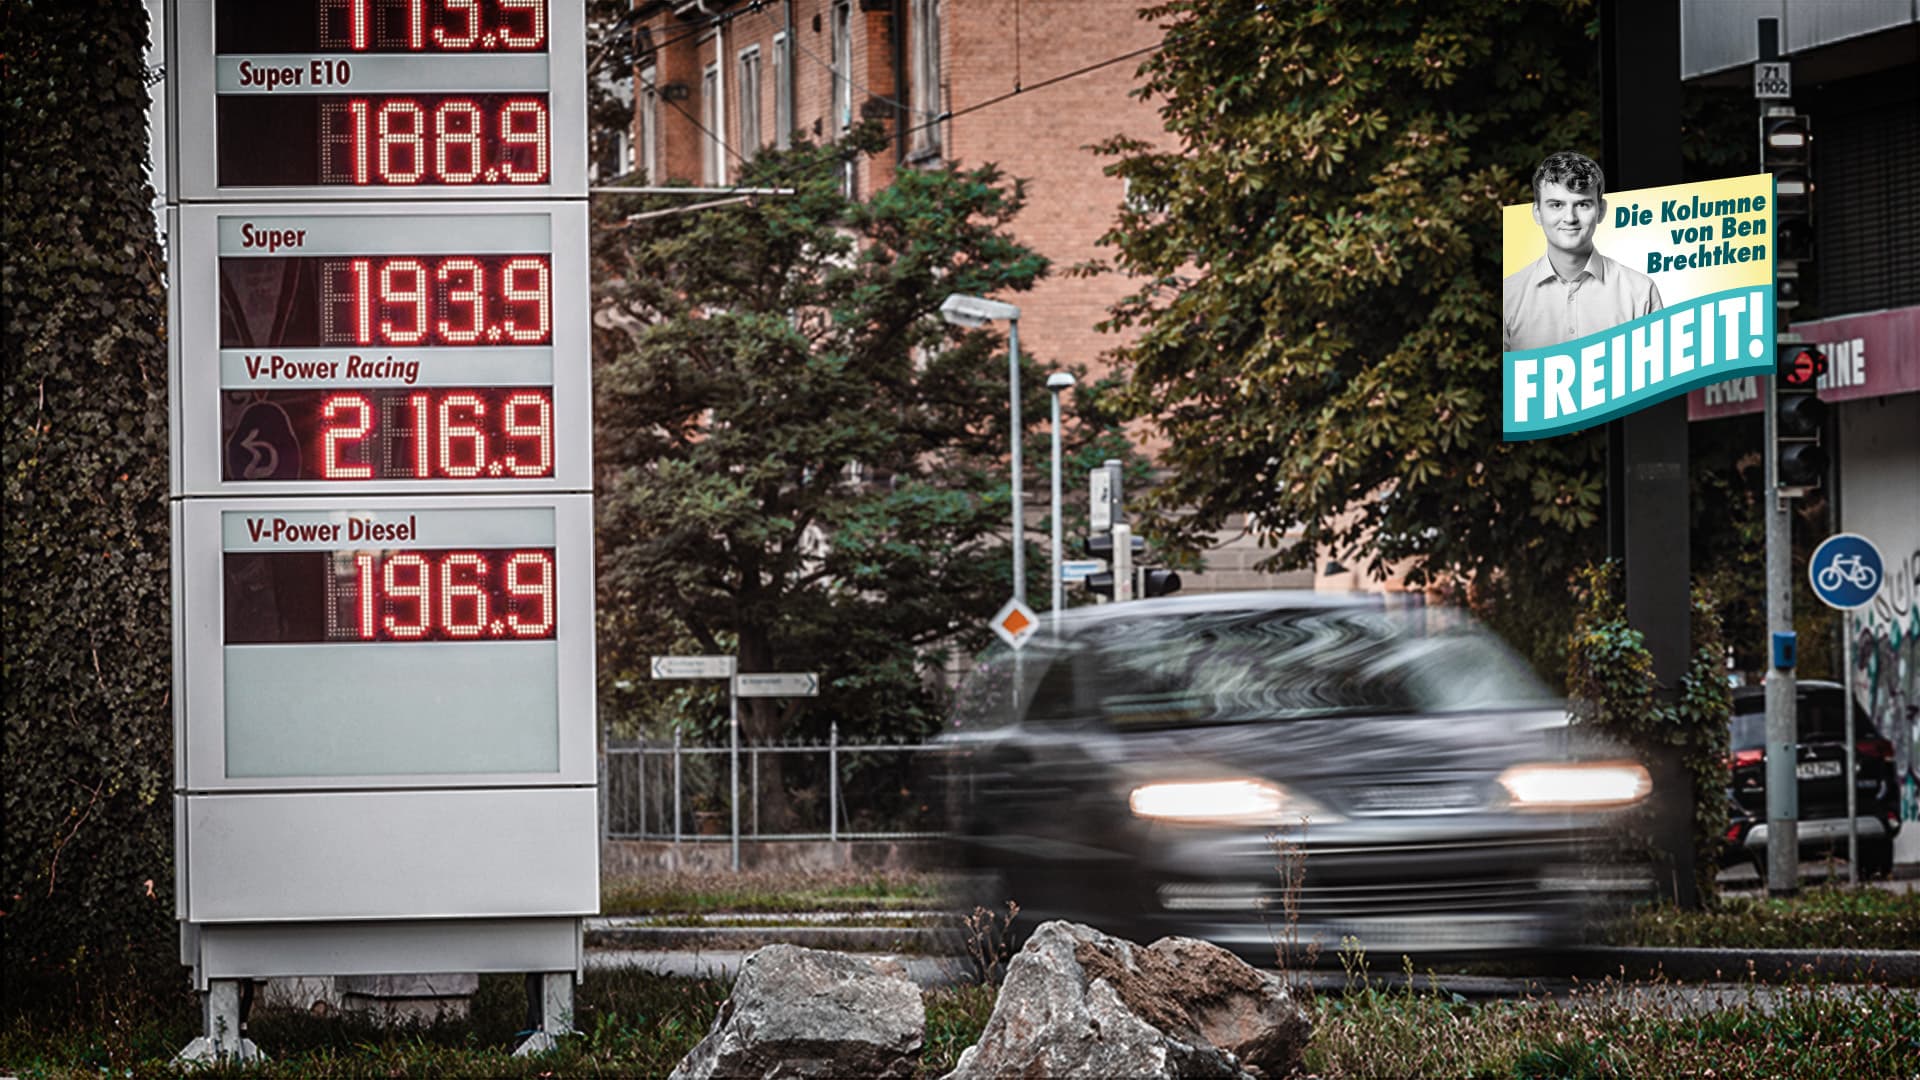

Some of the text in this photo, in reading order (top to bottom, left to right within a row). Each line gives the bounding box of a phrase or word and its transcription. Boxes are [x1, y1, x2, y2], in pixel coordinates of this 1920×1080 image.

[239, 60, 351, 91] Super E10
[1757, 80, 1788, 94] 1102
[1763, 66, 1780, 79] 71
[351, 101, 548, 184] 188.9
[242, 223, 306, 253] Super
[353, 259, 550, 343] 193.9
[245, 356, 420, 384] V-Power Racing
[246, 515, 416, 543] V-Power Diesel
[356, 552, 553, 638] 196.9
